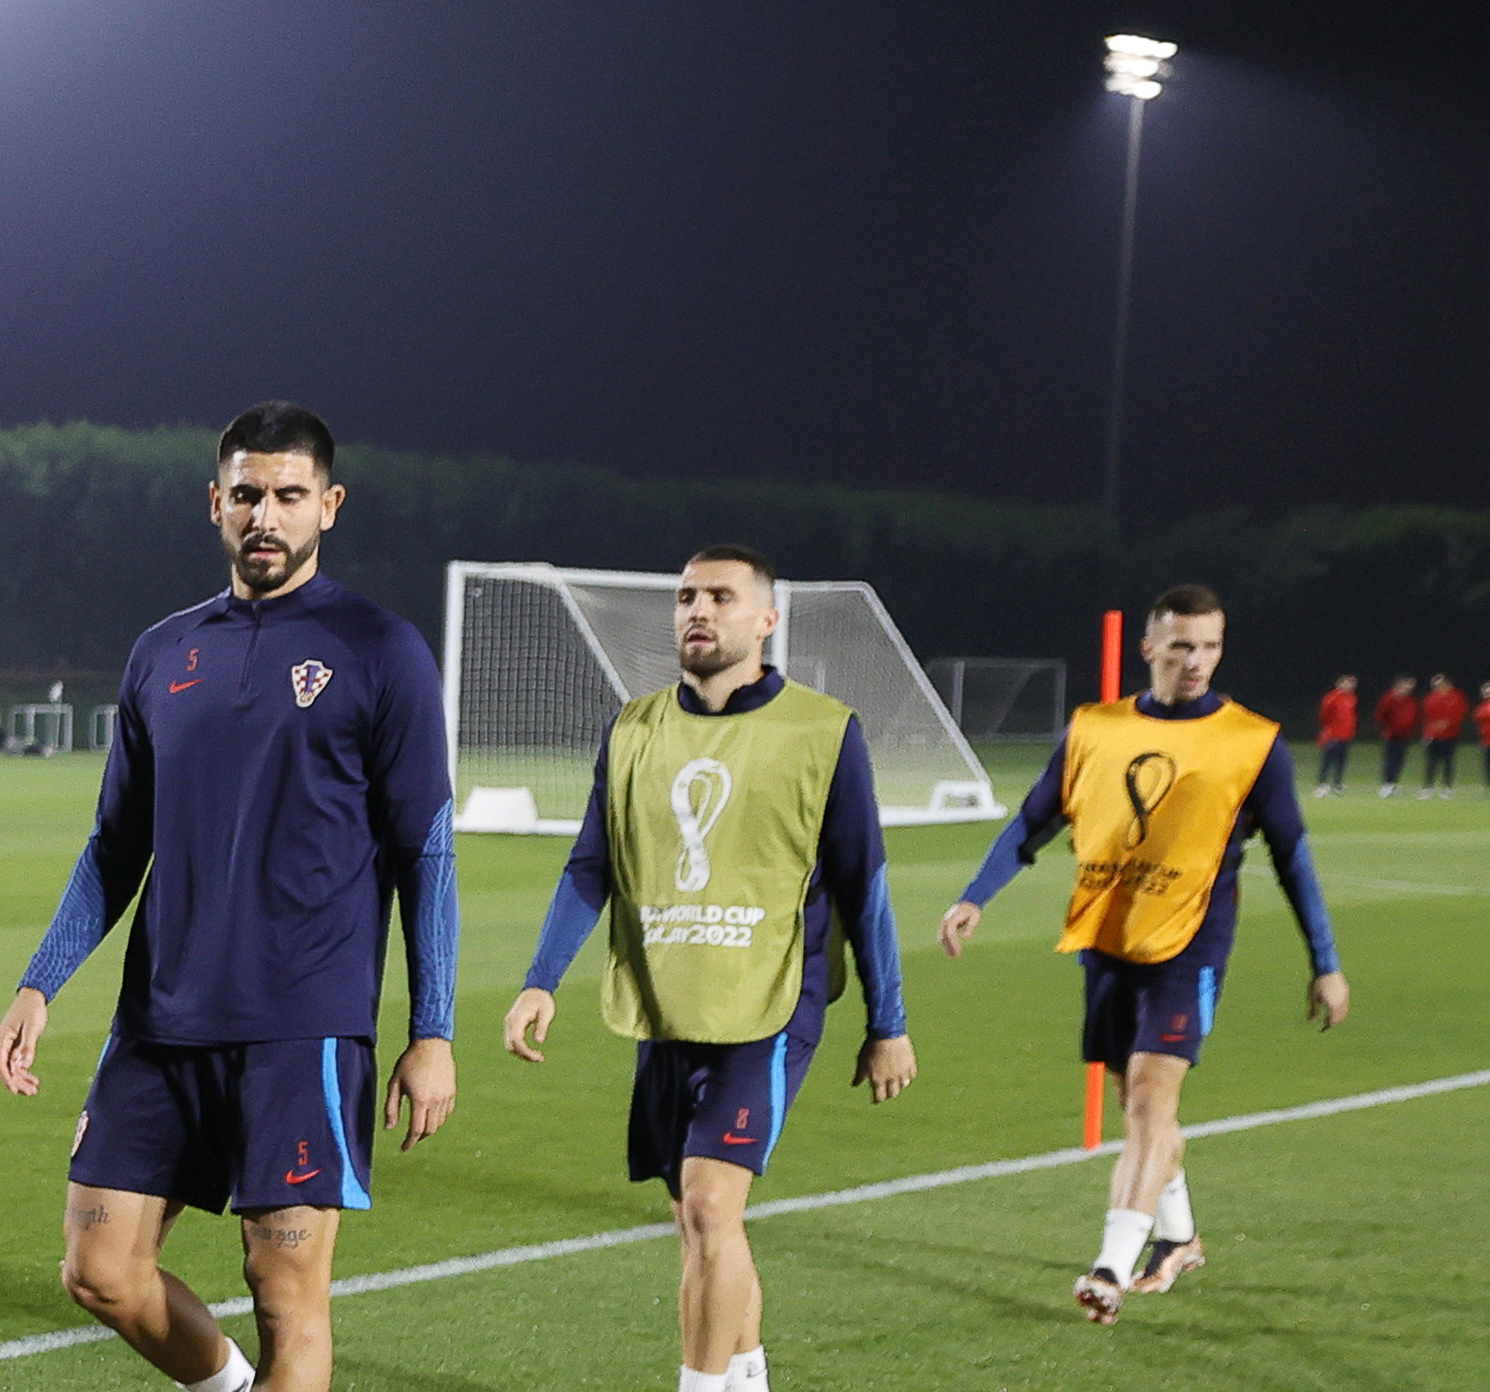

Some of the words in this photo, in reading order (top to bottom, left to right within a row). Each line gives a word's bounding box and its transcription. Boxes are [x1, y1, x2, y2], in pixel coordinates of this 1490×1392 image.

[185, 648, 200, 671] 5
[723, 905, 766, 926] CUP
[297, 1140, 309, 1166] 5
